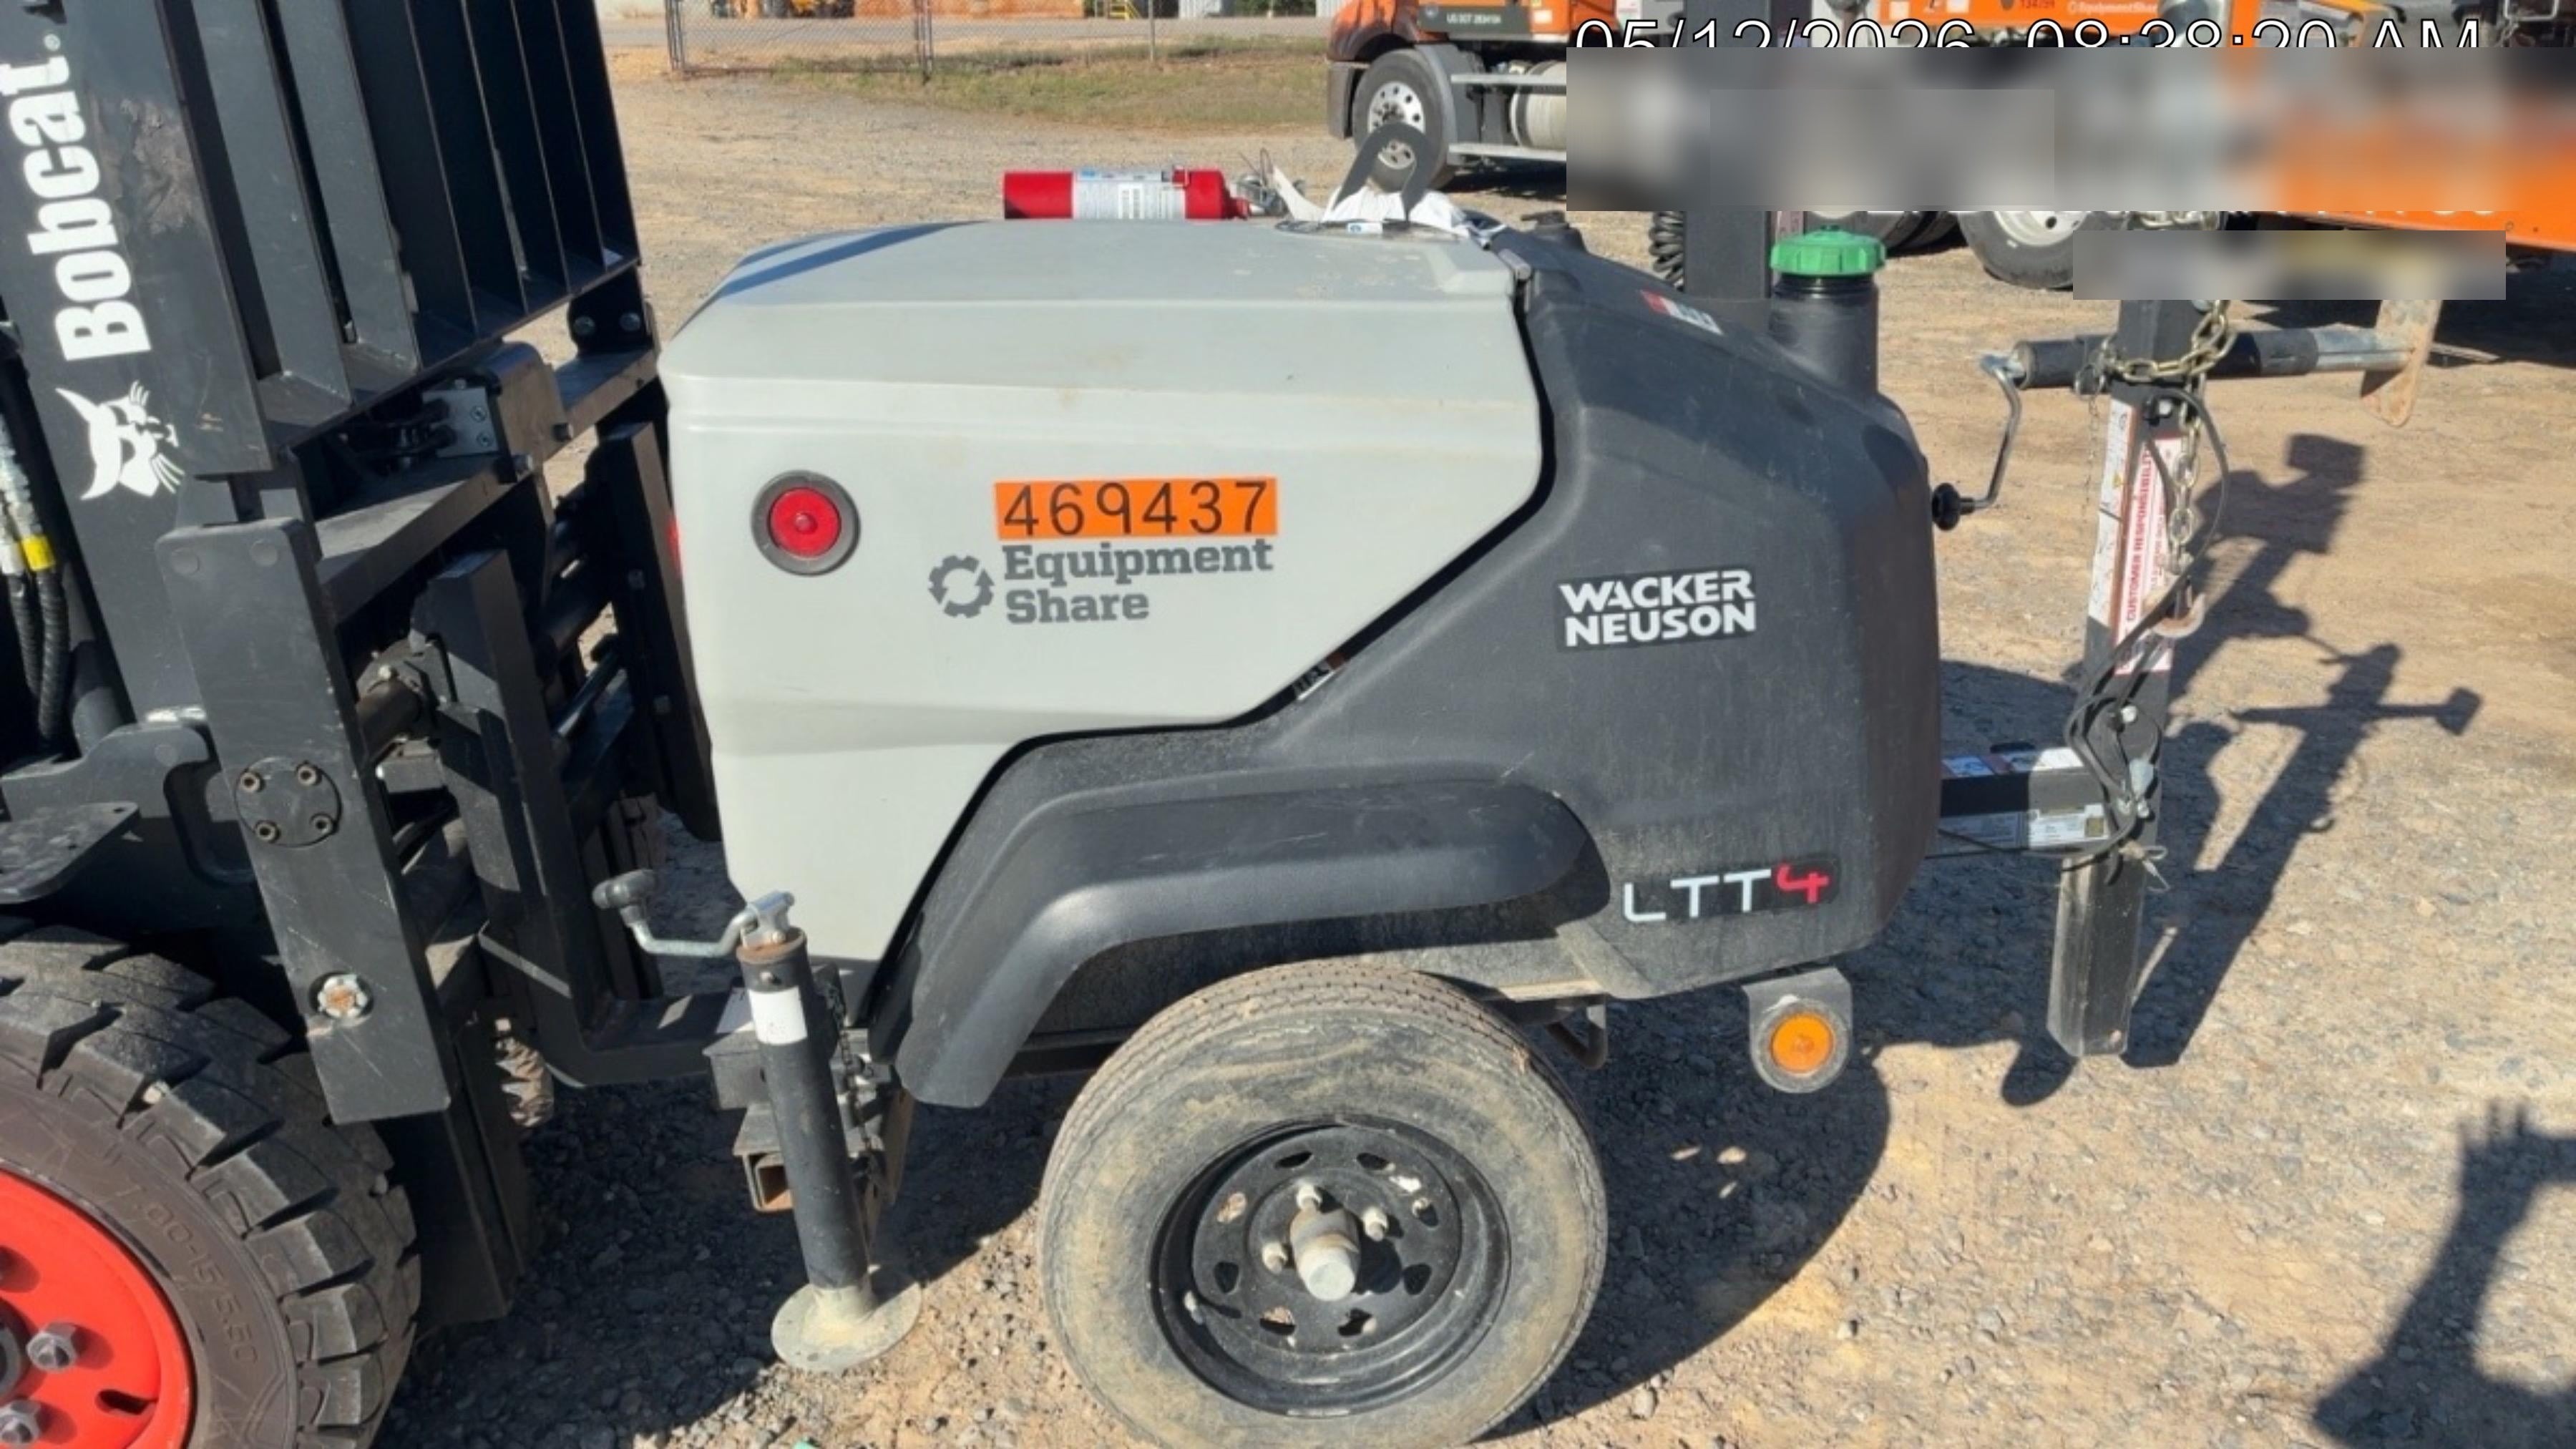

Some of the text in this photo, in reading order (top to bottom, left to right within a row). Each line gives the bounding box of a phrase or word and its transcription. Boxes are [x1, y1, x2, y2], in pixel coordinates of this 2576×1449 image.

[0, 55, 152, 361] Bobcat
[1003, 481, 1267, 535] 469437
[1002, 539, 1274, 586] Equipment
[1005, 589, 1149, 624] Share
[1558, 569, 1755, 614] WACKER
[1565, 601, 1756, 647] NEUSON
[1623, 862, 1830, 922] LTT4
